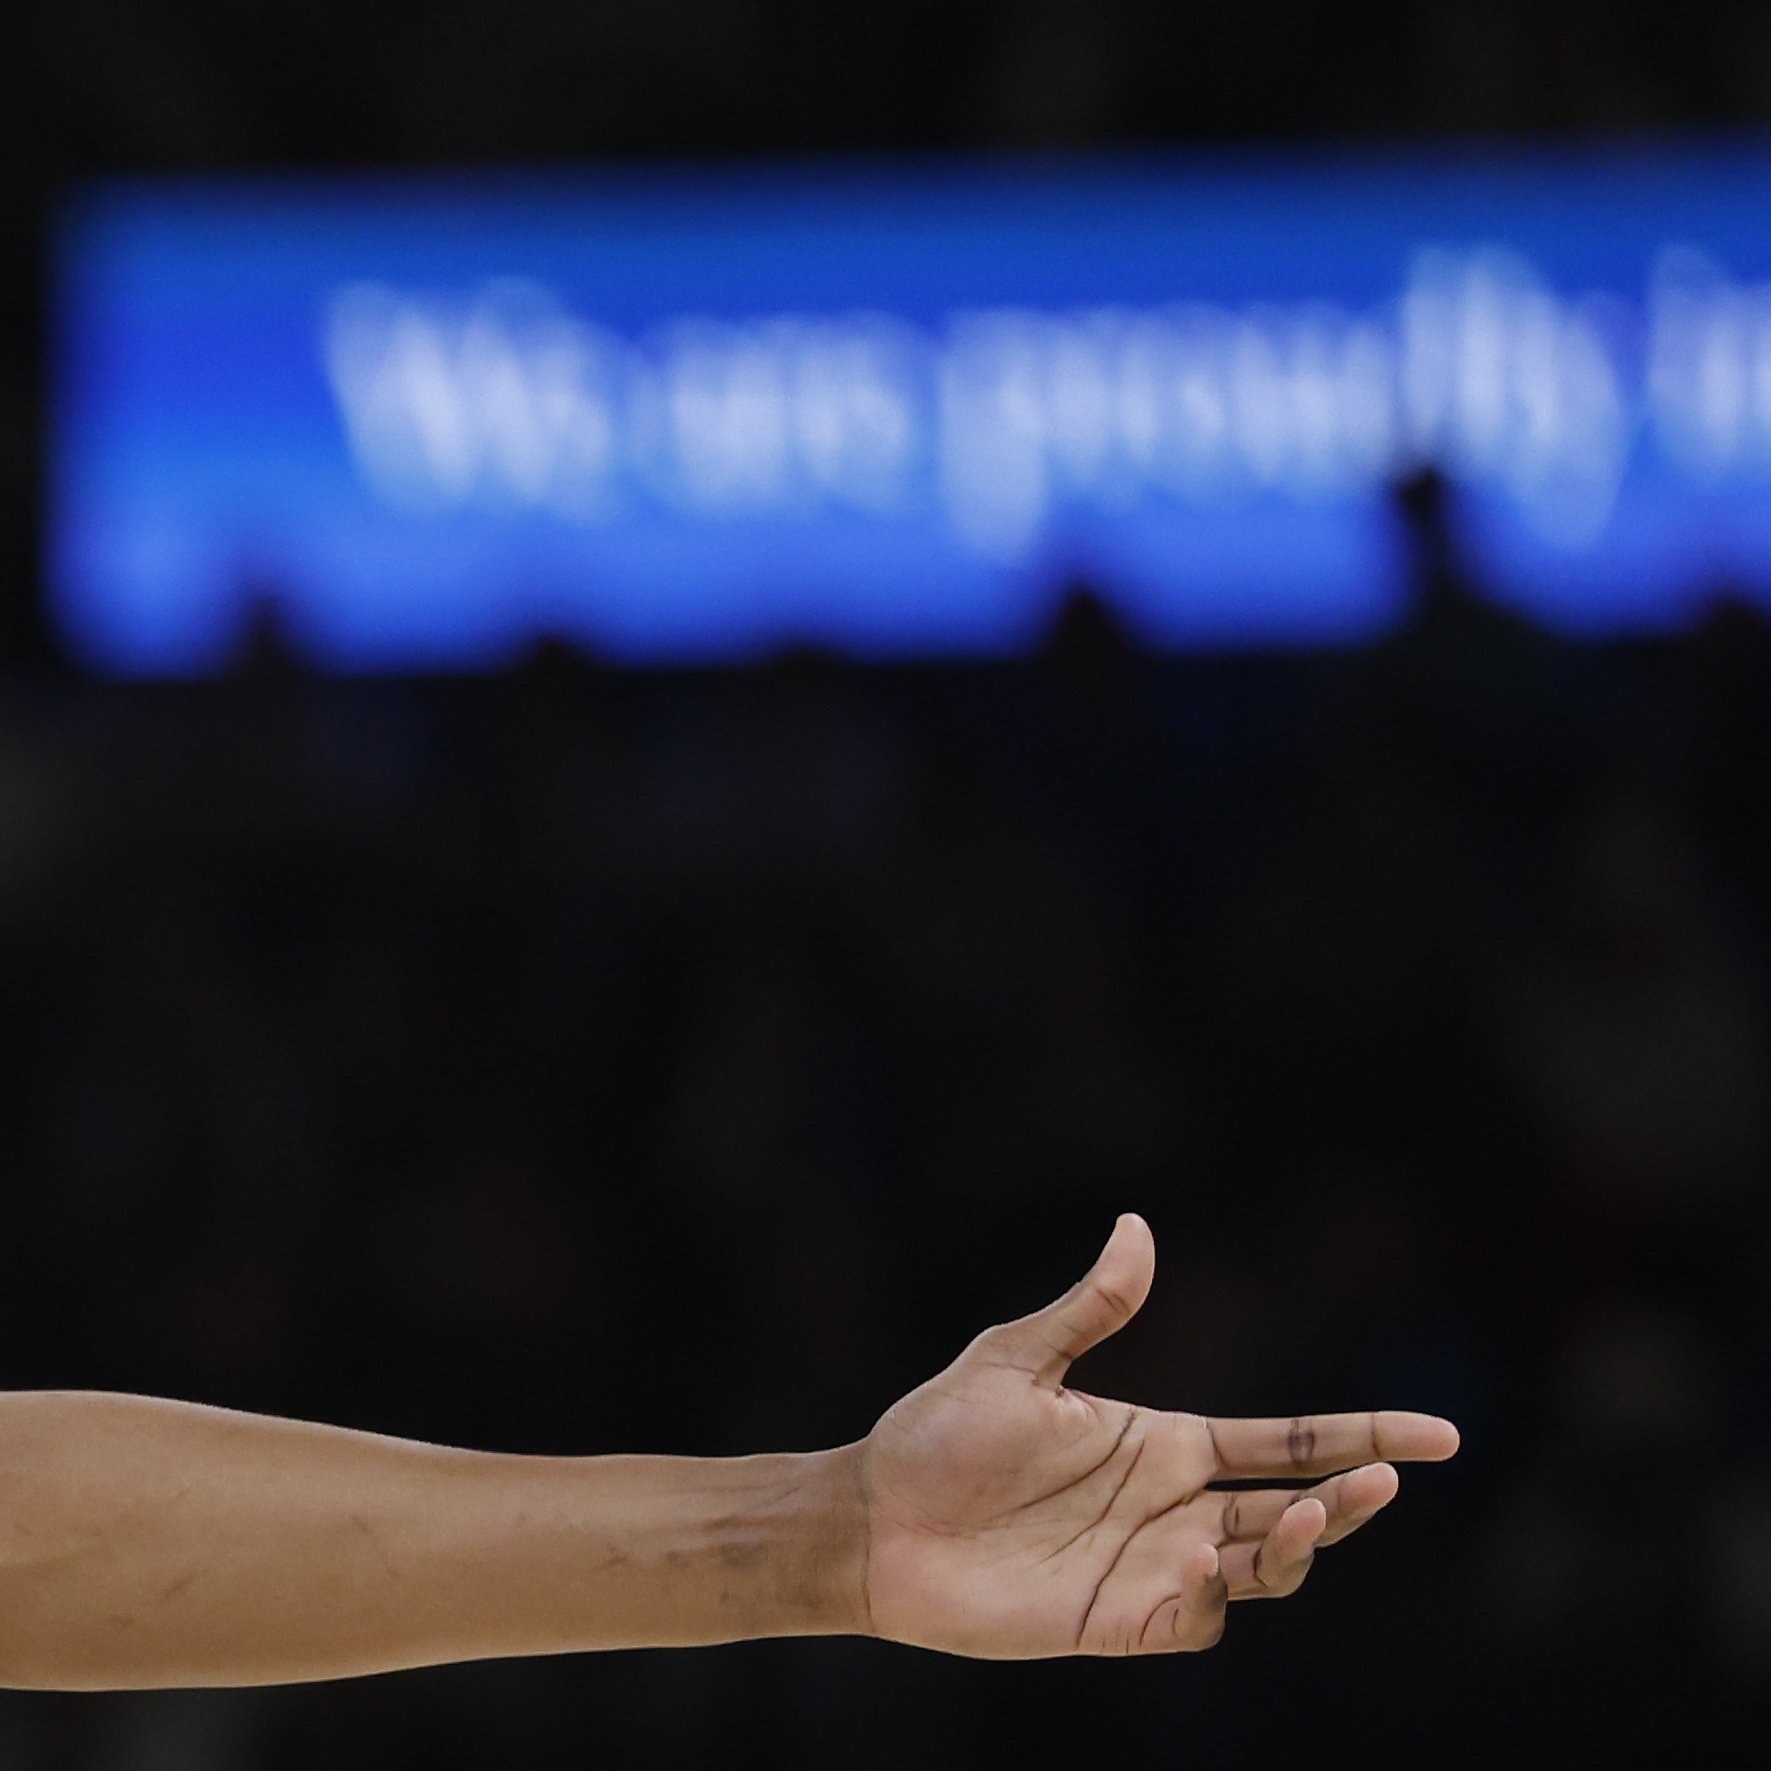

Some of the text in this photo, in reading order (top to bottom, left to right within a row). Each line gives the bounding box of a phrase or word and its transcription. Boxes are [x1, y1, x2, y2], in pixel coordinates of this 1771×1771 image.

[324, 280, 626, 516] We
[634, 312, 916, 514] are
[940, 240, 1626, 562] proudly
